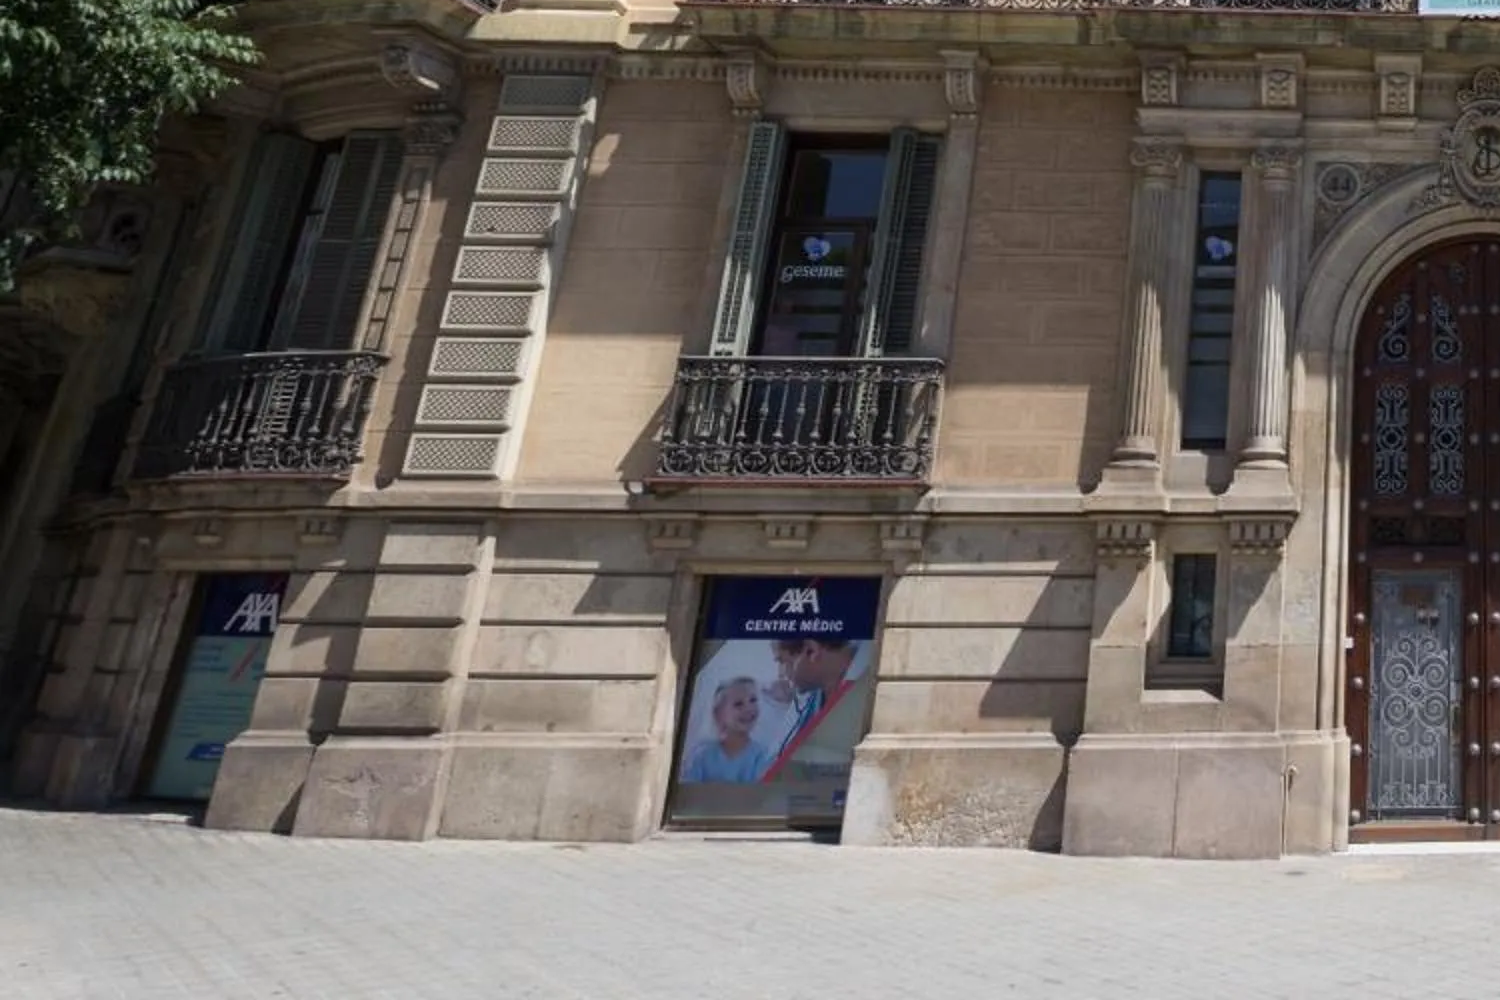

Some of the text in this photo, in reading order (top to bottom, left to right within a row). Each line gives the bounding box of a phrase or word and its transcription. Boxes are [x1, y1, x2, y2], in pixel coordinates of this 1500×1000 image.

[223, 593, 280, 633] AXA
[769, 588, 820, 614] AXA
[745, 619, 798, 632] CENTRE
